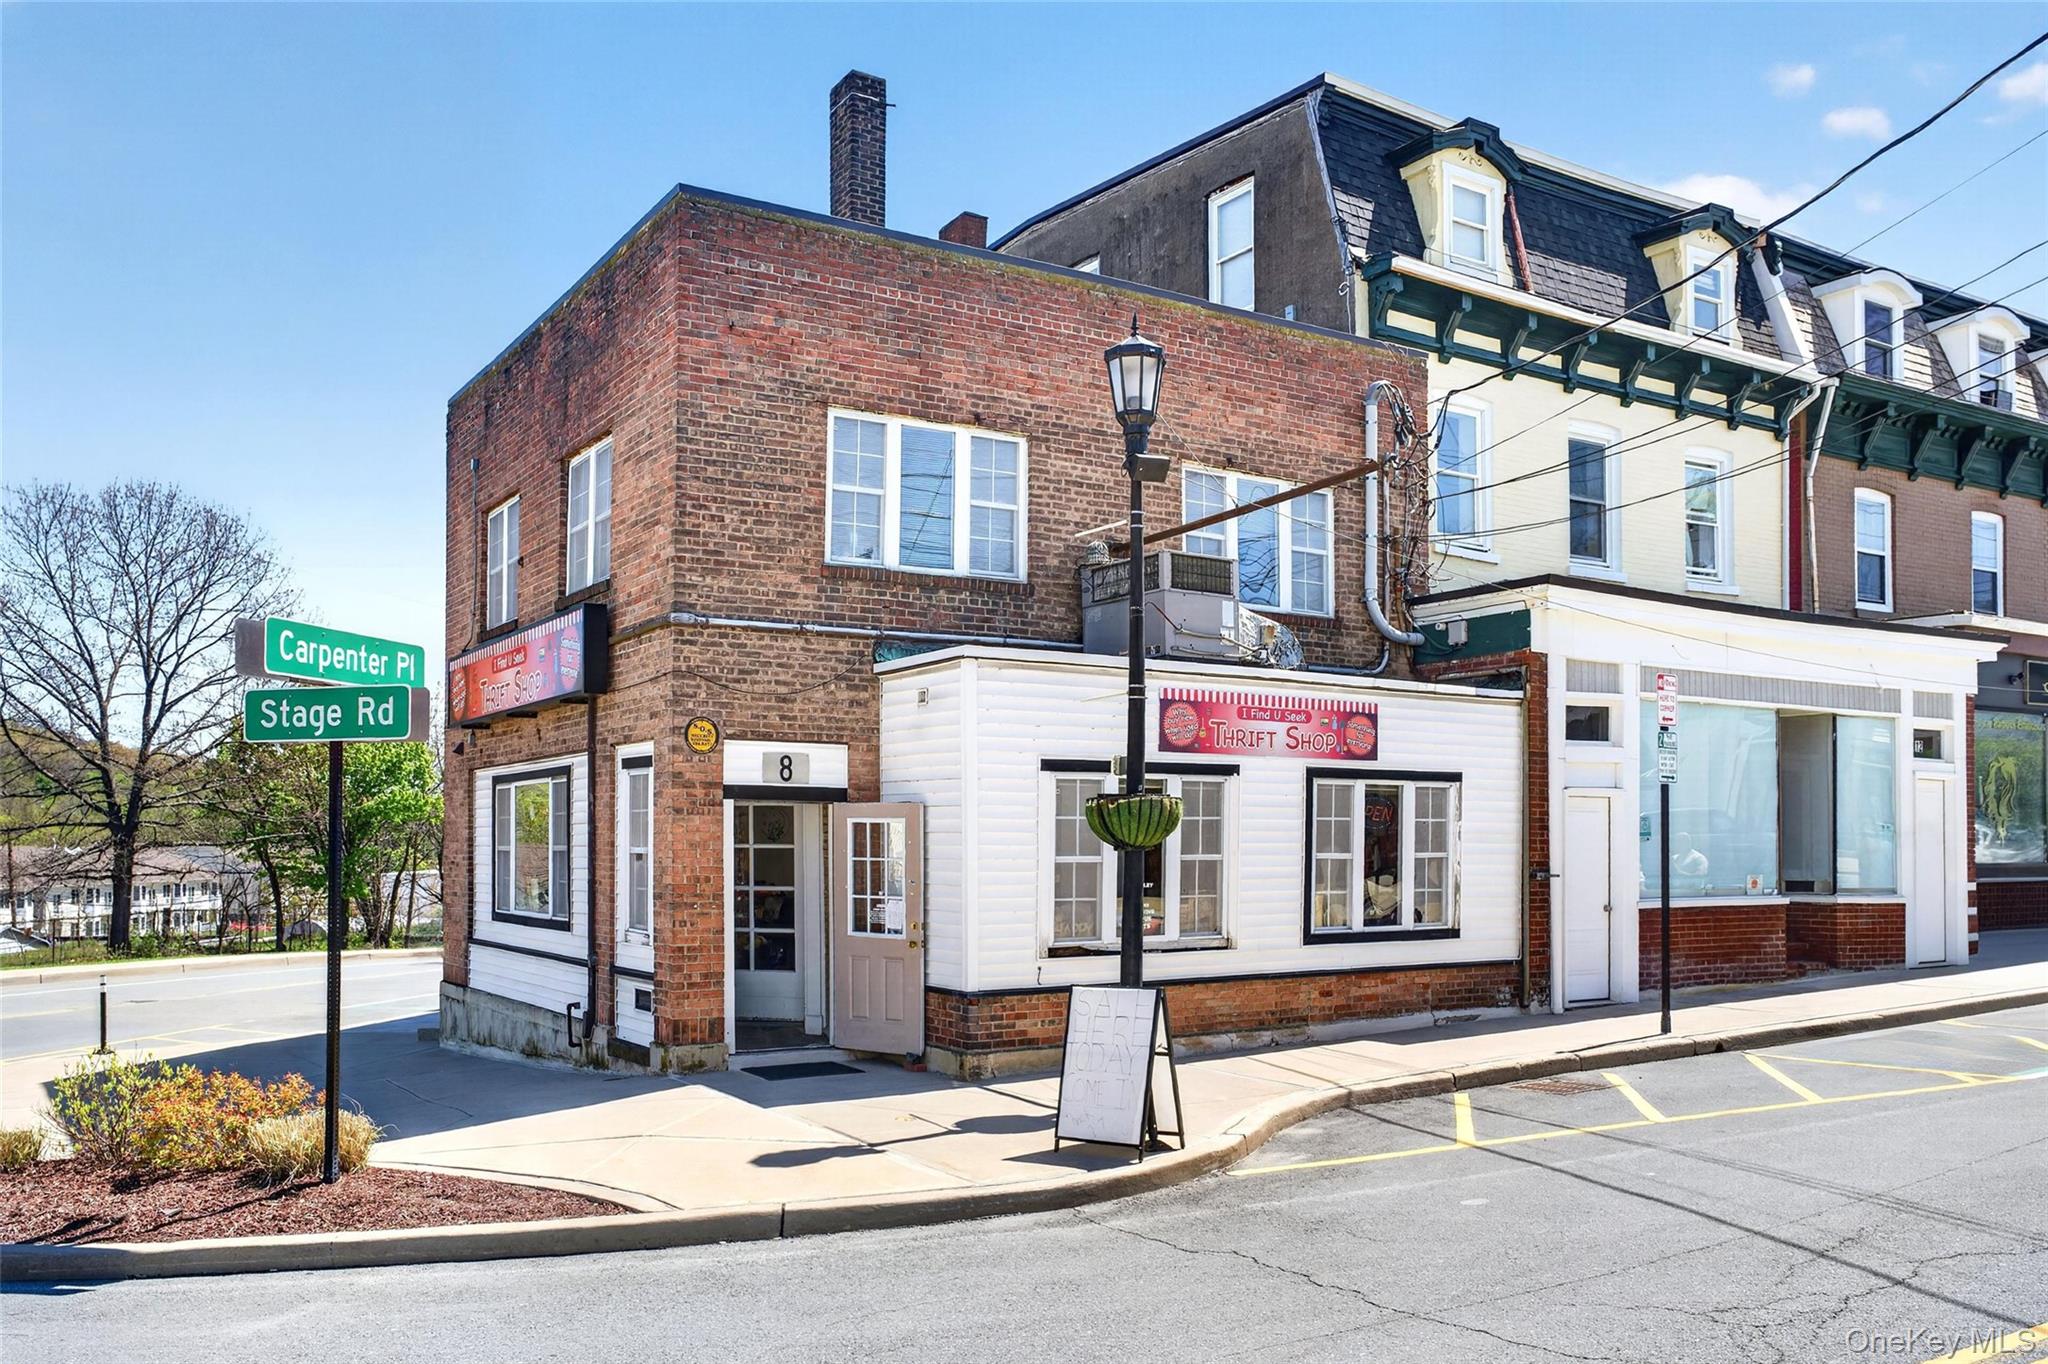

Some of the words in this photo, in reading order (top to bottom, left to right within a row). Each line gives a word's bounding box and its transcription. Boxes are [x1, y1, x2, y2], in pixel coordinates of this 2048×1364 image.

[278, 629, 389, 678] Carpenter
[396, 652, 415, 681] Pl
[513, 668, 543, 704] SHOP
[260, 698, 342, 737] Stage
[357, 695, 394, 726] Rd
[1242, 708, 1247, 719] I
[1250, 708, 1271, 720] Find
[1274, 710, 1281, 721] U
[1284, 711, 1307, 722] Seek
[1209, 719, 1277, 750] THRIFT
[1285, 725, 1337, 753] SHOP
[779, 754, 793, 783] 8
[1067, 1042, 1143, 1076] TODAY
